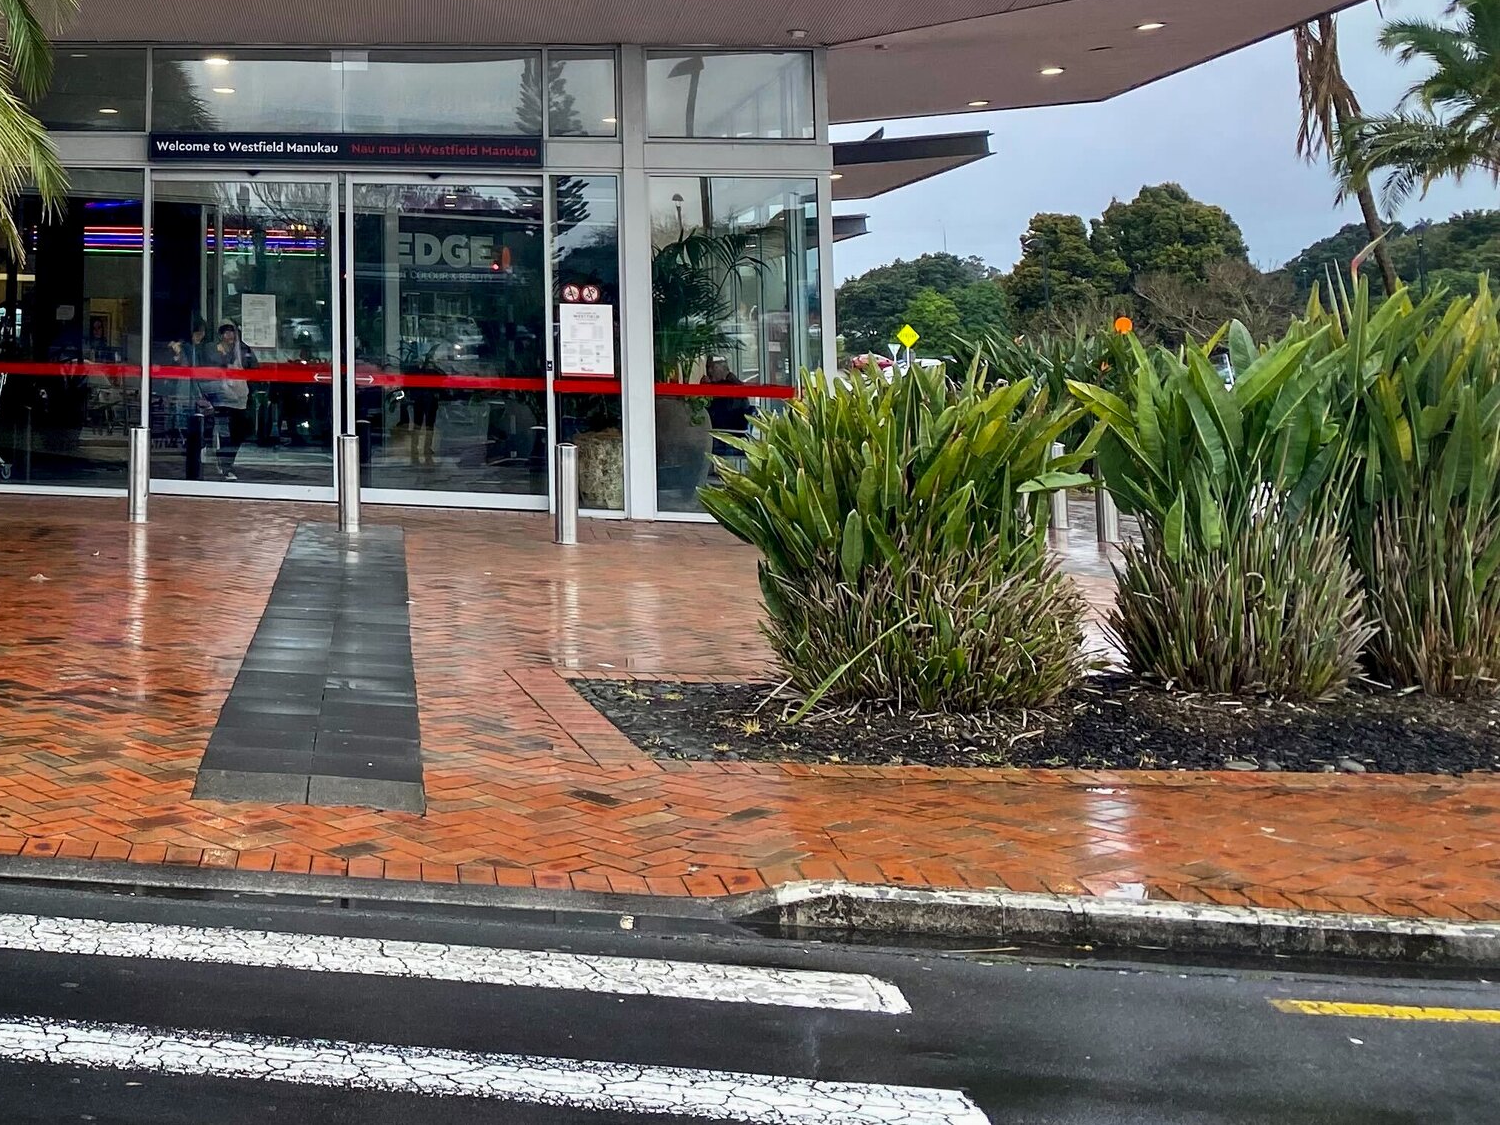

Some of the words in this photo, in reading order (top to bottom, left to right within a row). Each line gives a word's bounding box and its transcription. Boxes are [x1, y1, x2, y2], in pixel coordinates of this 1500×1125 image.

[156, 140, 210, 152] Welcome
[213, 141, 226, 152] to
[228, 140, 284, 153] Westfield
[286, 141, 339, 154] Manukau
[351, 143, 375, 154] Nau
[379, 143, 401, 155] mai
[403, 143, 416, 155] ki
[418, 144, 478, 156] Westfield
[481, 145, 537, 157] Manukau
